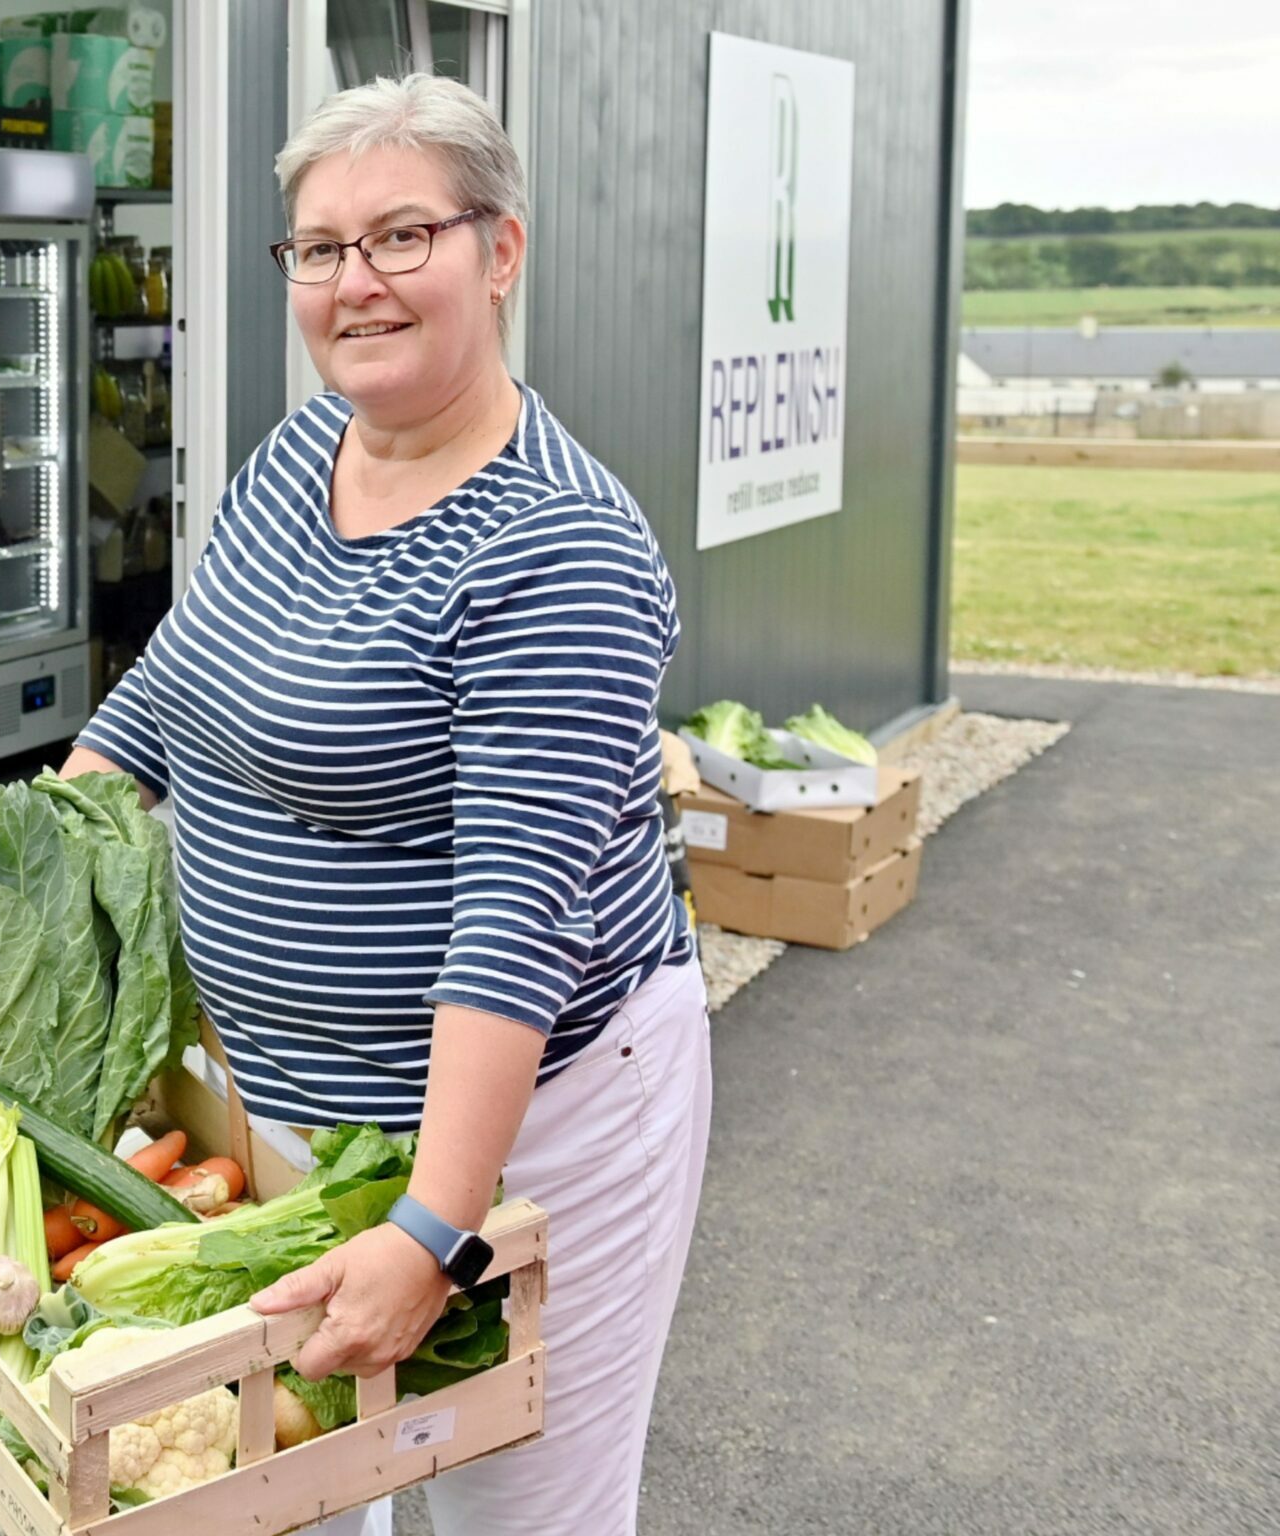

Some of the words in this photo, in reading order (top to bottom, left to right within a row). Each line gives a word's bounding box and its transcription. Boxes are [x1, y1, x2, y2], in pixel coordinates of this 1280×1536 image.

[767, 72, 800, 324] R
[709, 346, 840, 464] REPLENISH
[727, 481, 753, 515] refill
[756, 480, 785, 506] reuse
[787, 470, 821, 497] reduce
